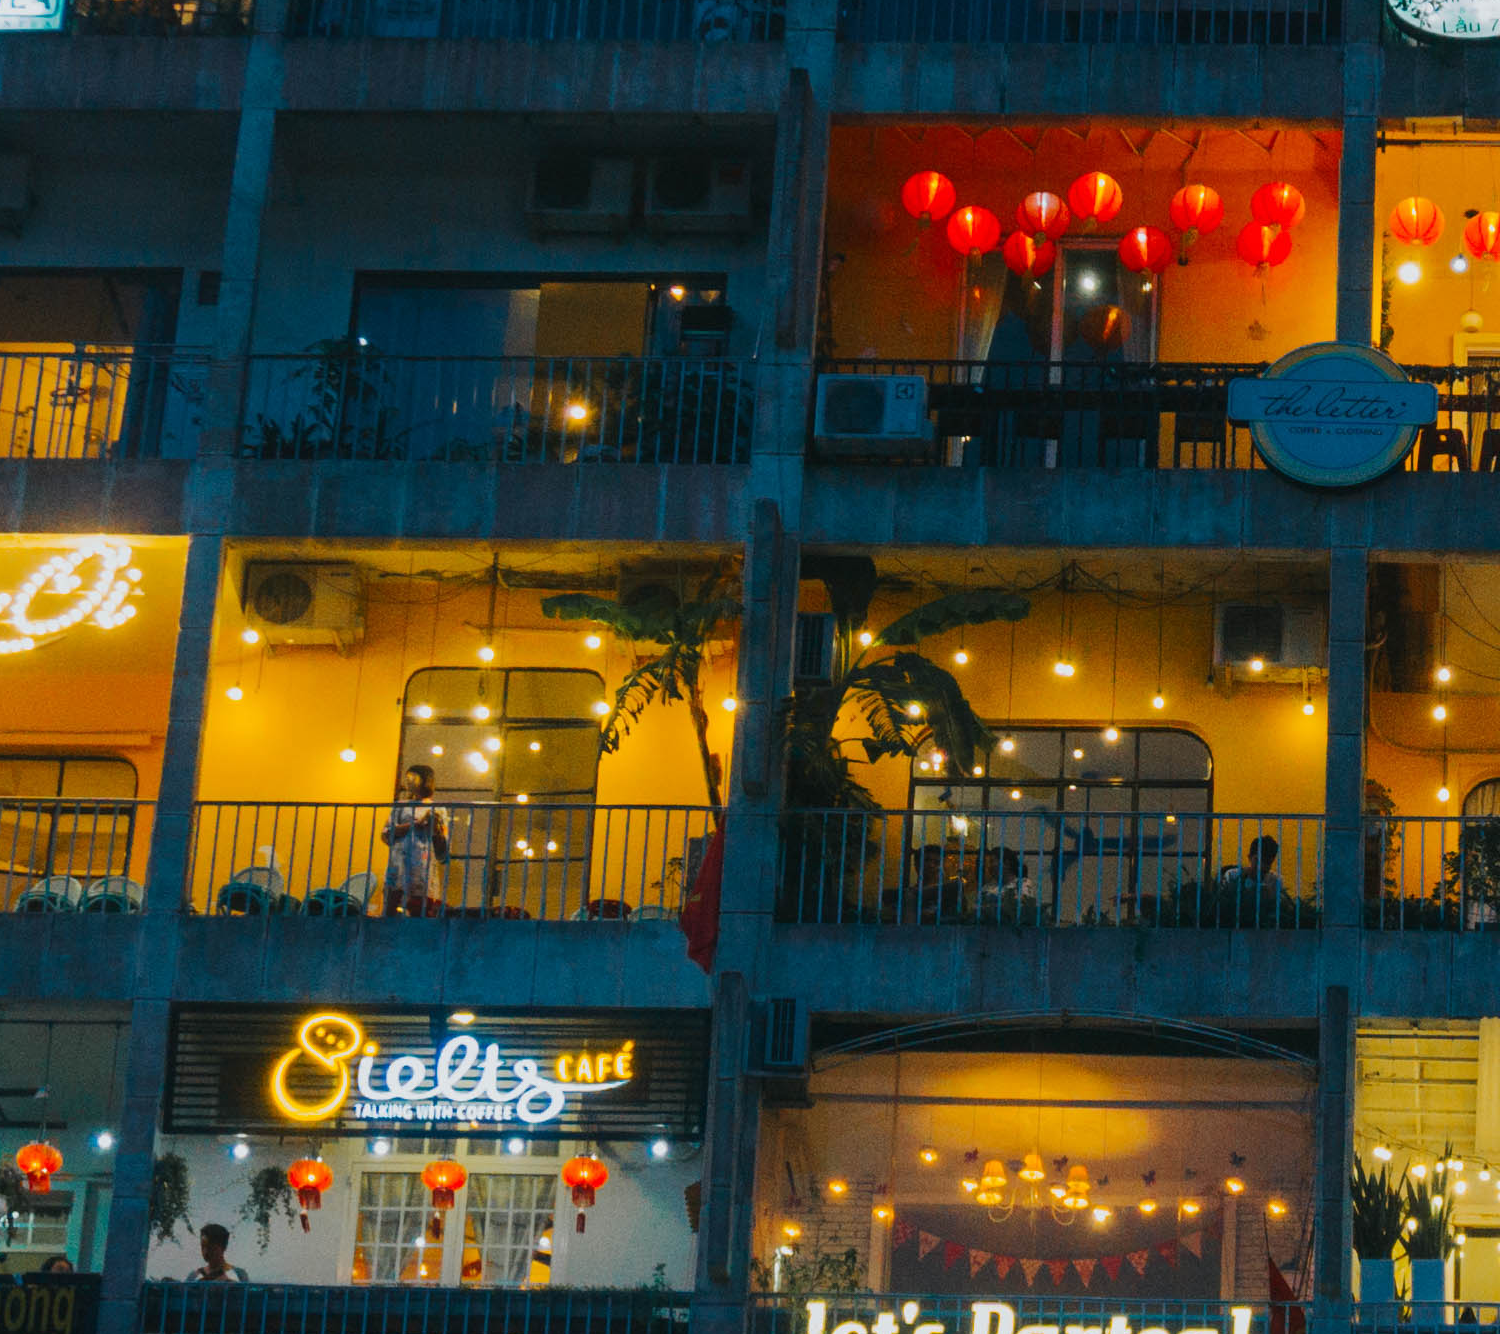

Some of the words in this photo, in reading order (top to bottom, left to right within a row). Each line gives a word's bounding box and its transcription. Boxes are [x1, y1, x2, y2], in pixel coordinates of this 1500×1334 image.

[1258, 384, 1312, 418] the
[355, 1103, 414, 1122] TALKING
[415, 1103, 454, 1122] WITH
[456, 1103, 514, 1122] COFFEE
